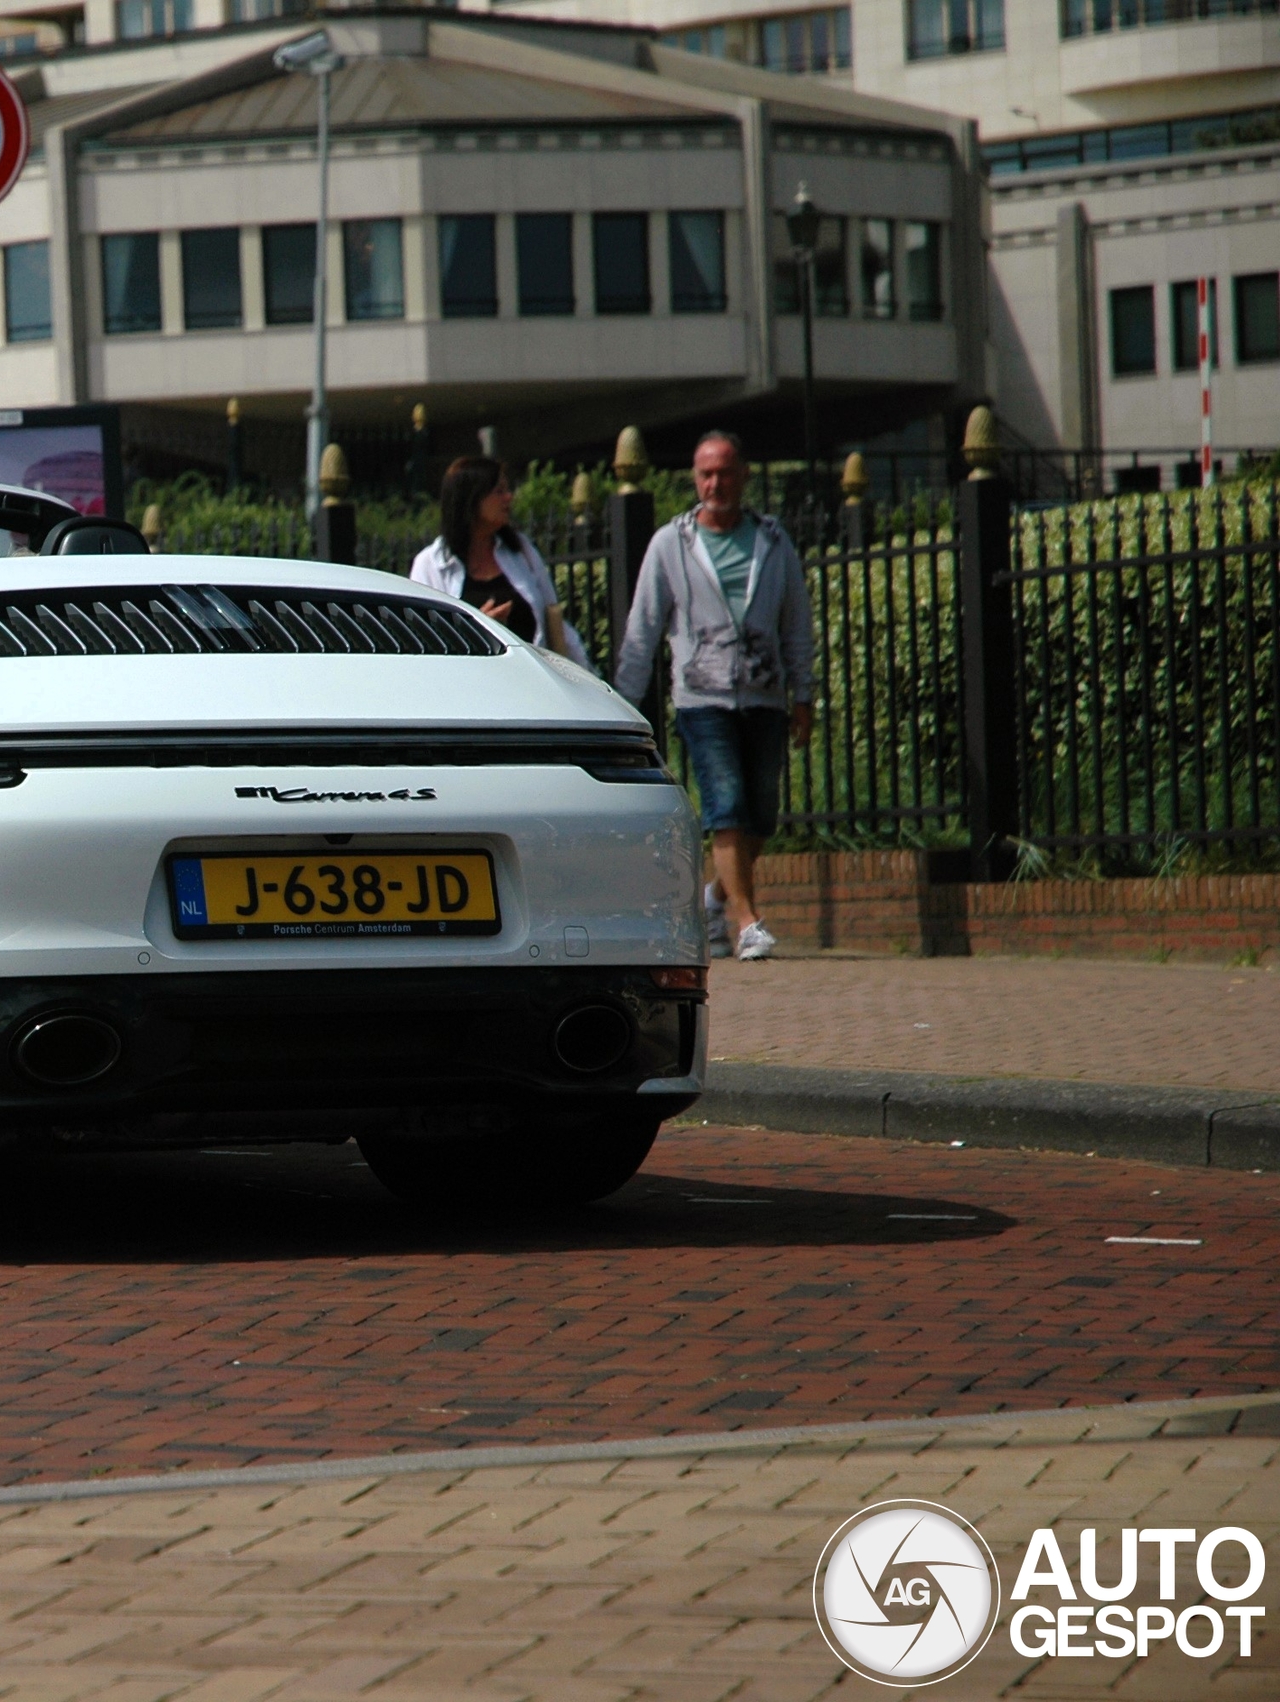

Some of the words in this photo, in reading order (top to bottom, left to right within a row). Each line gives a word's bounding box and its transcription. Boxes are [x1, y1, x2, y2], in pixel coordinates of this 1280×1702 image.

[272, 788, 387, 803] Carrera
[235, 864, 470, 916] J-638-JD
[181, 901, 202, 915] NL
[273, 924, 312, 935] Porsche
[314, 923, 355, 934] Centrum
[357, 922, 412, 933] Amsterdam
